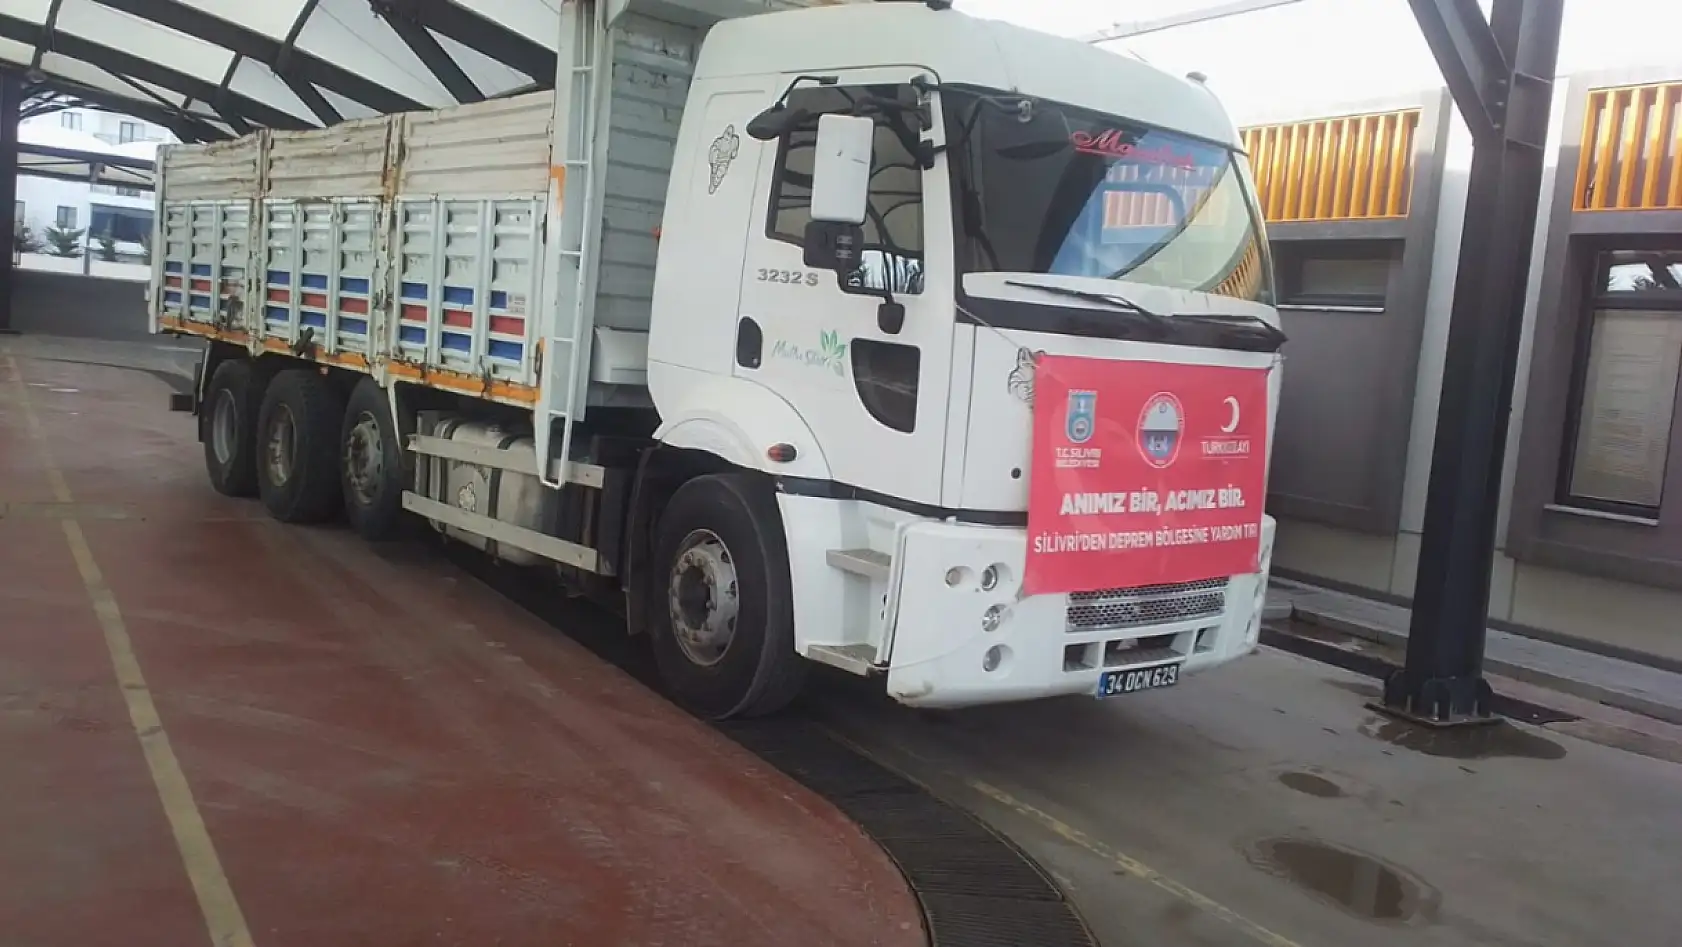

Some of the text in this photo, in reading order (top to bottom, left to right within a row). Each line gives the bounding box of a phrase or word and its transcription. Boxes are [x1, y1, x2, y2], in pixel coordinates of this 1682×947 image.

[757, 268, 818, 287] 3232 S
[1060, 493, 1126, 515] ANIMIZ
[1218, 483, 1245, 508] BİR.
[1108, 531, 1154, 549] DEPREM
[1155, 525, 1209, 546] BÖLGESİNE
[1106, 675, 1124, 694] 34
[1152, 666, 1177, 687] 629
